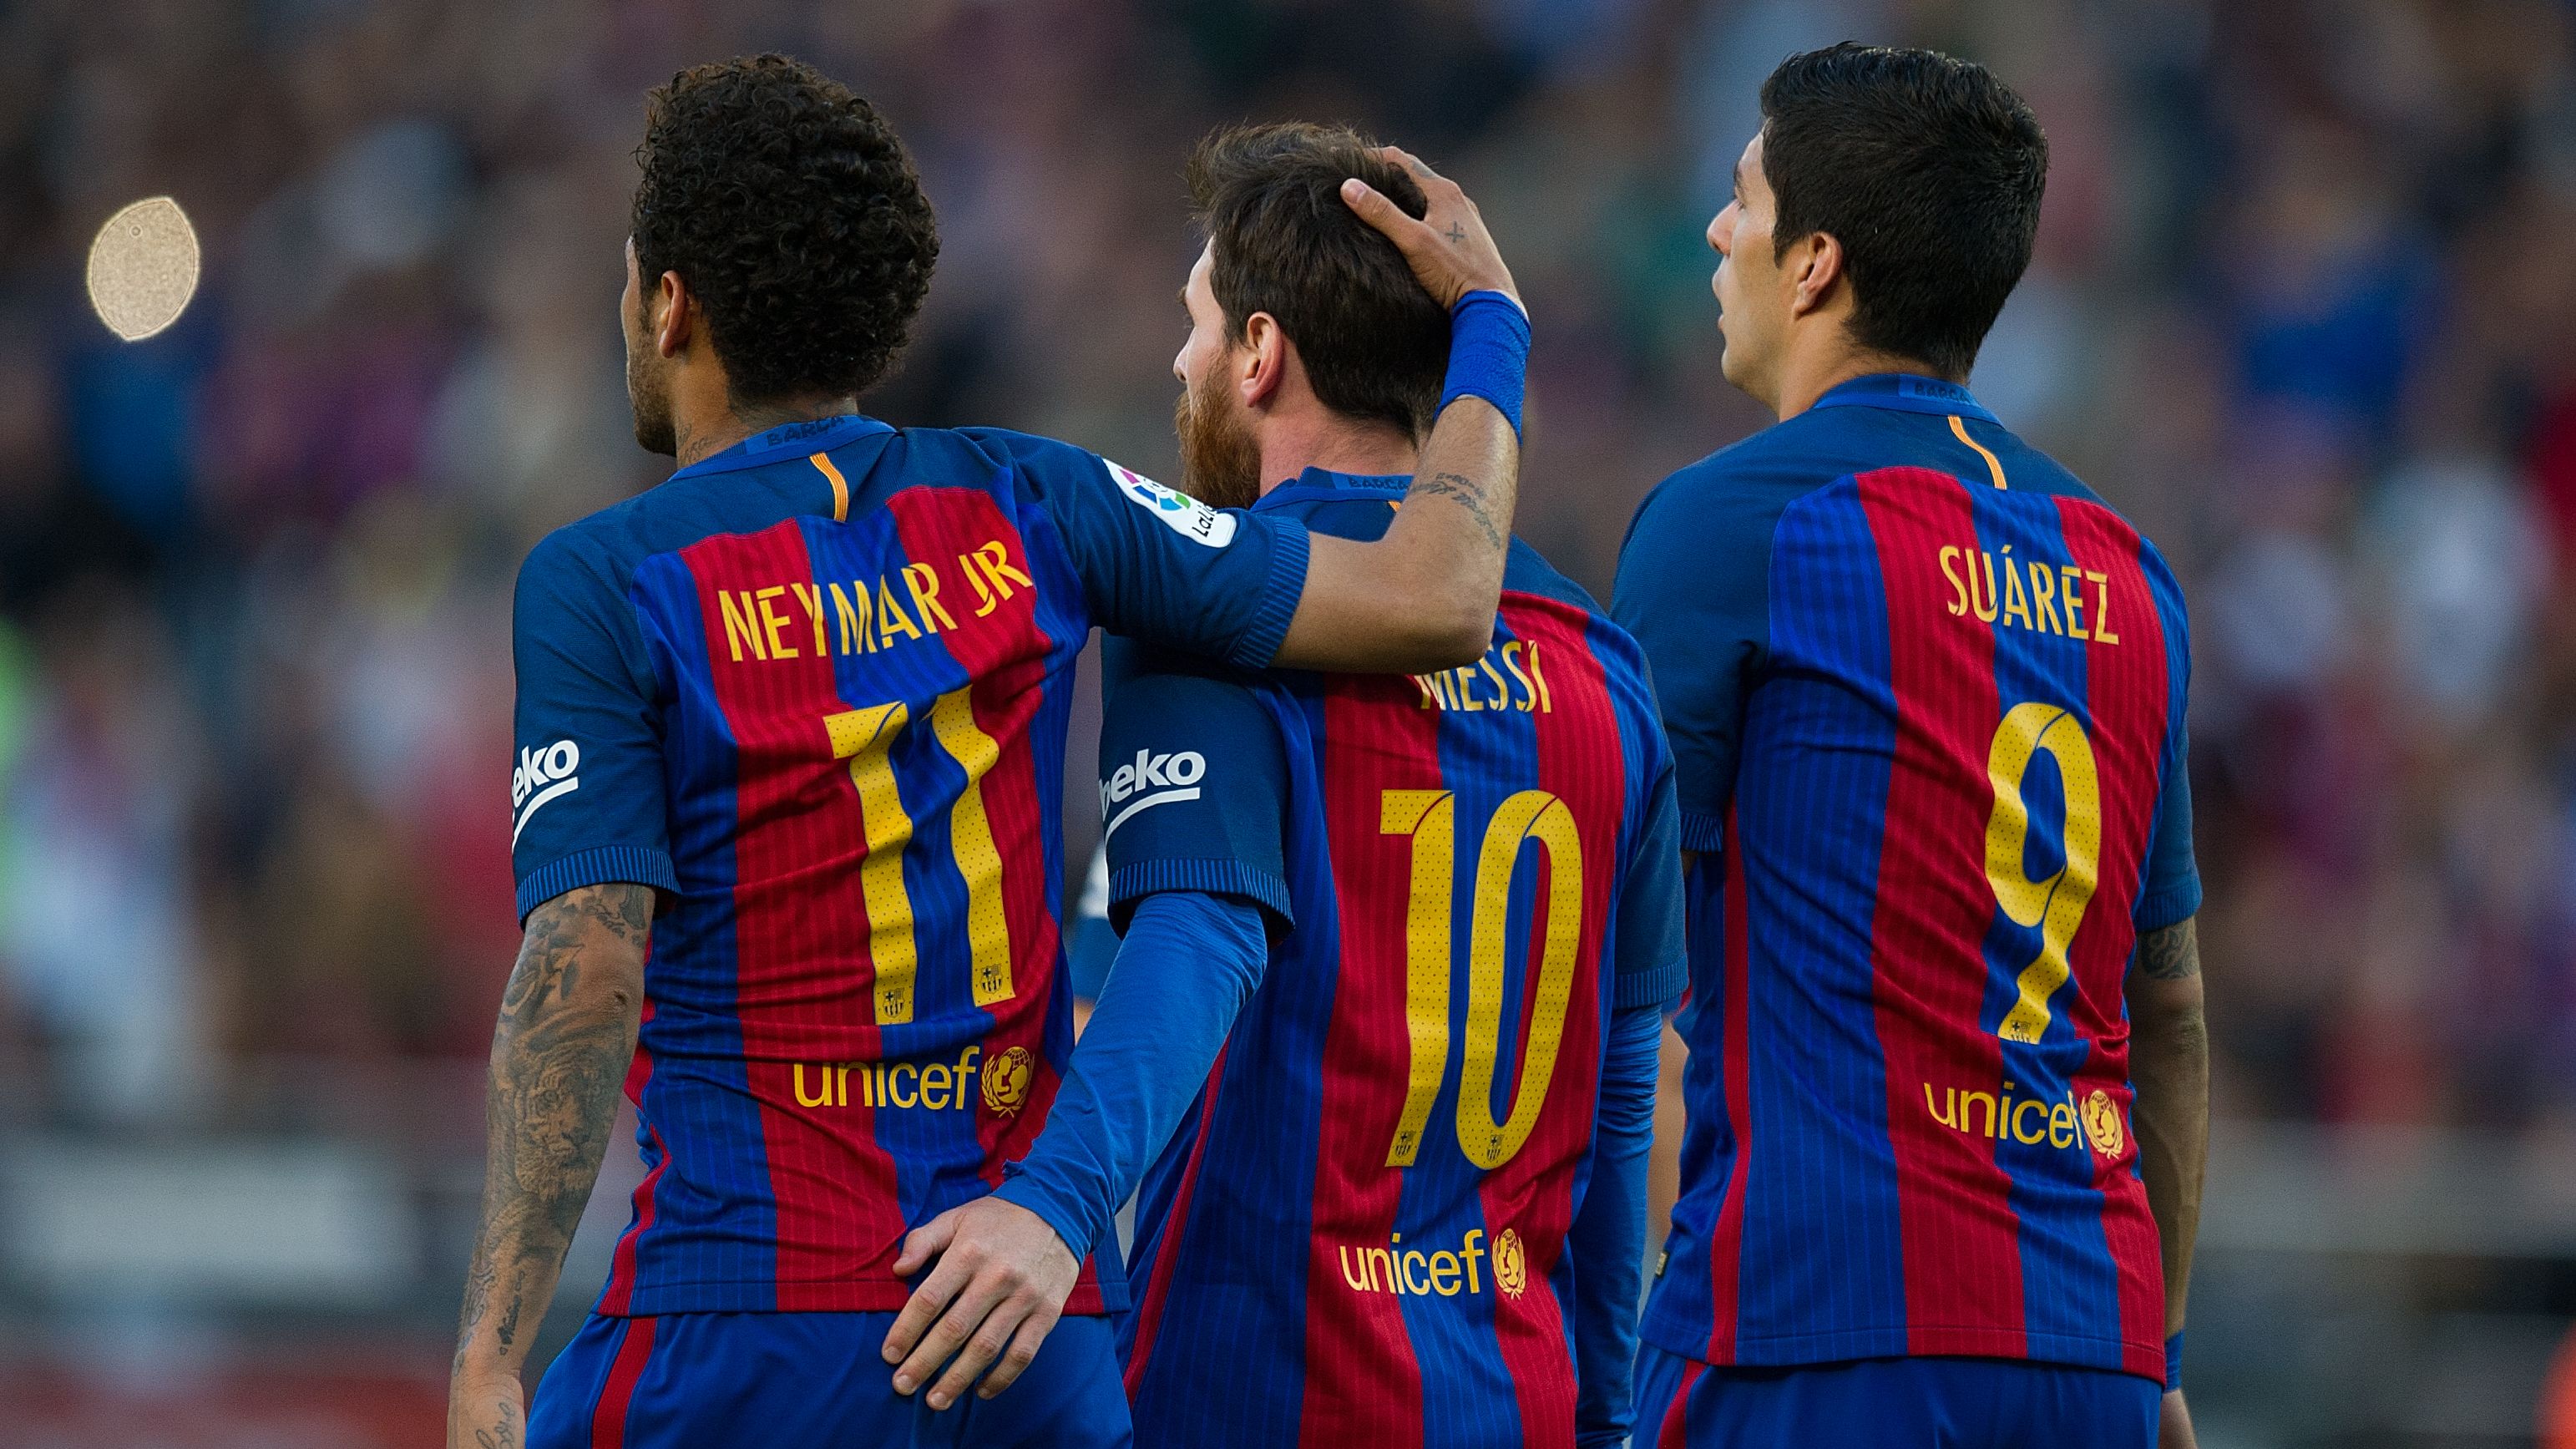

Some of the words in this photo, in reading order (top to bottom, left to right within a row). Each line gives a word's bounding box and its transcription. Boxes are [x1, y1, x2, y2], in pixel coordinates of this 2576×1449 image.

[718, 562, 957, 662] NEYMAR
[959, 540, 1032, 617] JR
[1939, 545, 2119, 645] SUÁREZ
[512, 740, 579, 808] eko
[823, 686, 1015, 1026] 11
[1985, 702, 2102, 1045] 9
[1379, 788, 1583, 1169] 10
[793, 1046, 980, 1111] unicef
[1339, 1229, 1485, 1296] unicef
